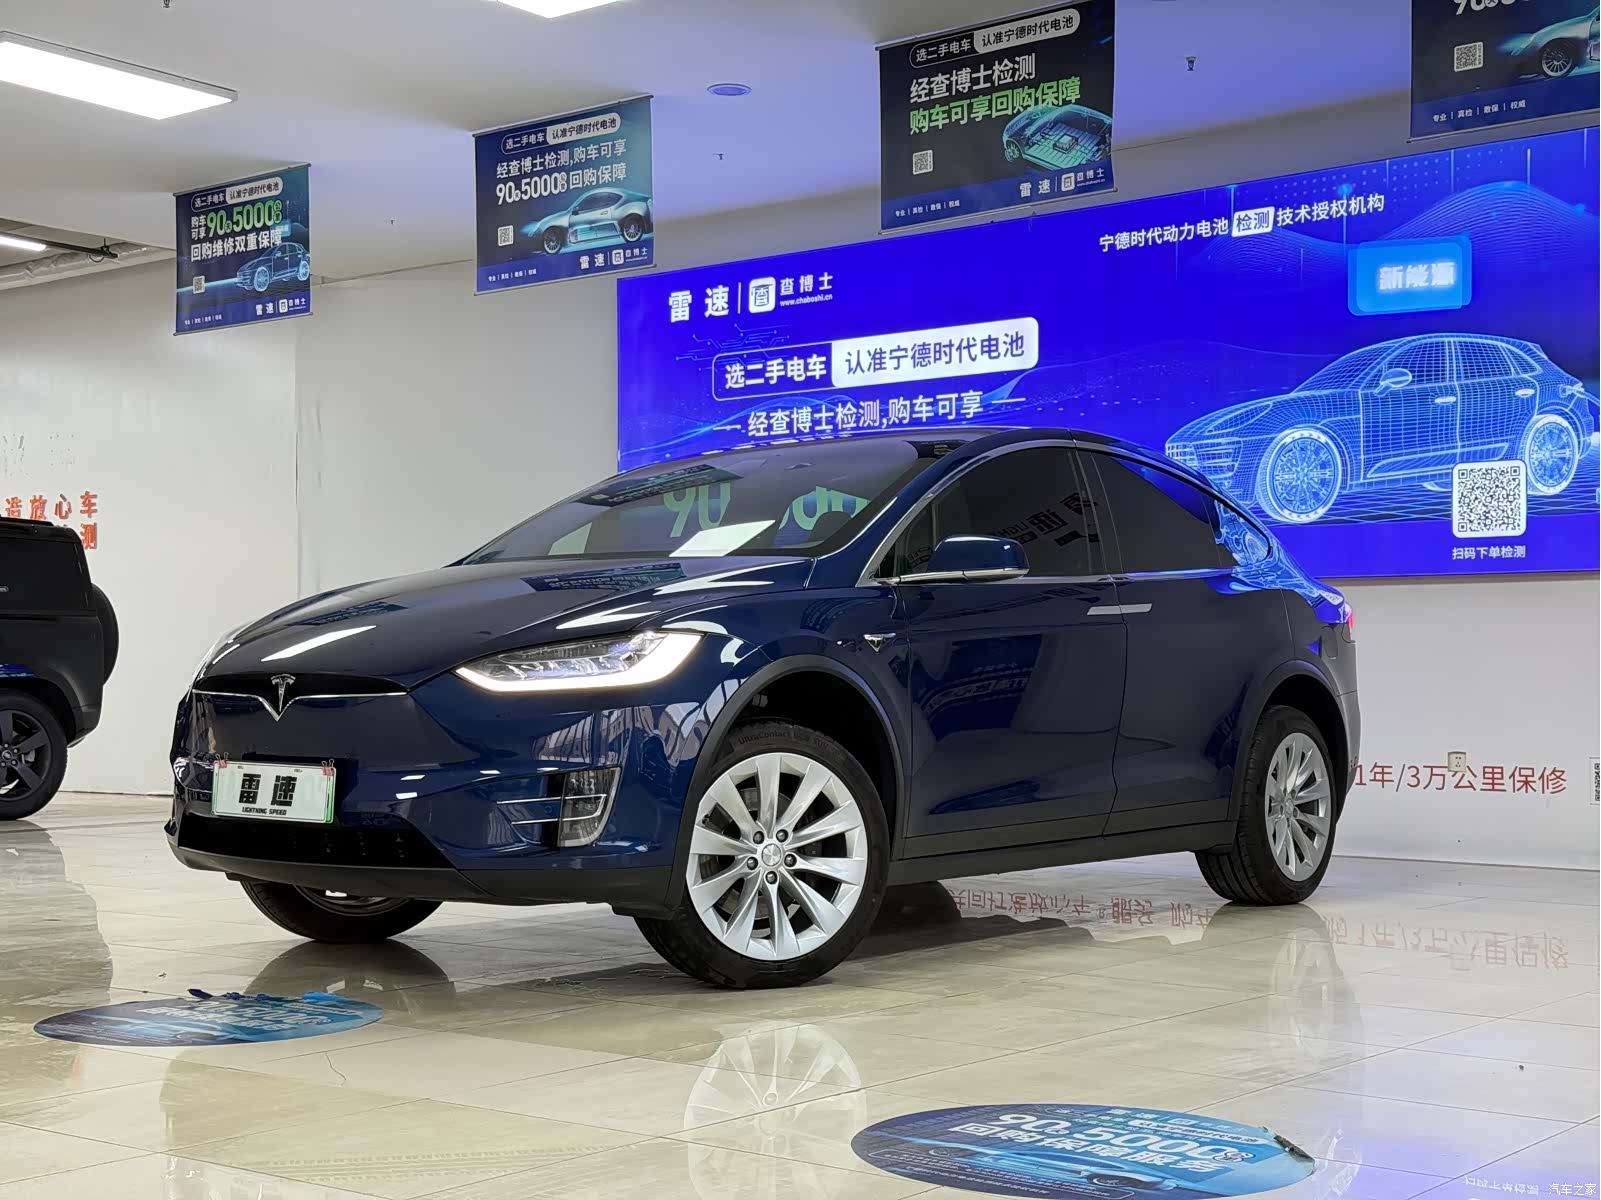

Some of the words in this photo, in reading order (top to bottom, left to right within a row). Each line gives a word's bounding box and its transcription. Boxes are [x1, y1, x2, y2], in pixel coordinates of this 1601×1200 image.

[916, 38, 972, 62] 选二手电车
[981, 15, 1074, 48] 认准宁德时代电池
[910, 53, 1036, 104] 经查博士检测
[910, 76, 1081, 135] 购车可享回购保障
[505, 132, 545, 150] 选二手电车
[552, 118, 617, 140] 认准宁德时代电池
[496, 139, 627, 179] 经查博士检测,购车可享
[1019, 179, 1051, 198] 雷速
[1099, 216, 1229, 253] 宁德时代动力电池
[1234, 209, 1272, 235] 检测
[1276, 193, 1385, 227] 技术授权机构
[190, 229, 283, 263] 回购维修双重保障
[1378, 261, 1456, 293] 新能源
[668, 285, 730, 323] 雷速
[779, 272, 834, 297] 查博士
[779, 293, 834, 308] www.chaboshi.cn
[724, 353, 828, 391] 选二手电车
[845, 331, 1026, 376] 认准宁德时代电池
[747, 390, 984, 438] 经查博士检测,购车可享
[1452, 544, 1527, 562] 扫码下单检测
[238, 773, 298, 807] 雷速
[1354, 762, 1567, 794] 1年/3万公里保修
[242, 807, 268, 815] LIGHTNING
[269, 808, 287, 816] SPEED
[947, 1123, 1231, 1173] 回购保障服务
